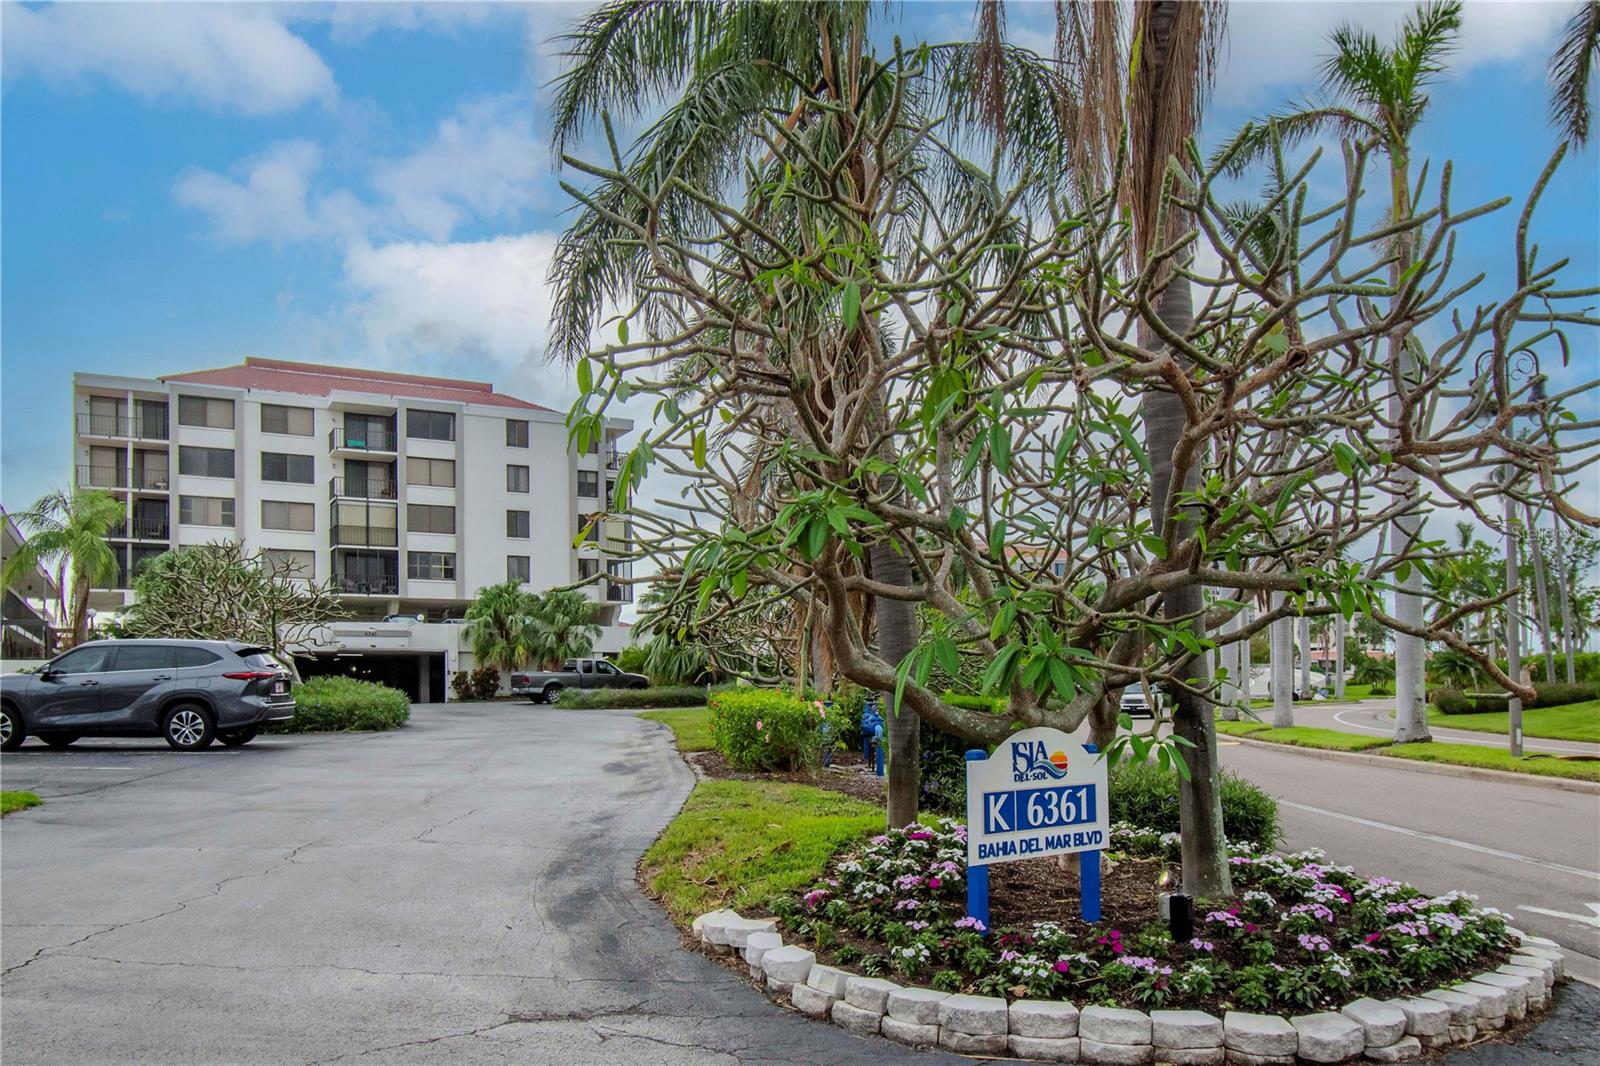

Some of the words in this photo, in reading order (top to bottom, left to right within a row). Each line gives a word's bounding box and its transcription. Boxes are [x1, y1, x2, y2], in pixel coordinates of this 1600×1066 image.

[989, 794, 1010, 832] K
[1027, 788, 1087, 826] 6361
[978, 841, 1017, 859] BAHIA
[1020, 837, 1043, 854] DEL
[1045, 835, 1071, 850] MAR
[1074, 831, 1102, 846] BLVD
